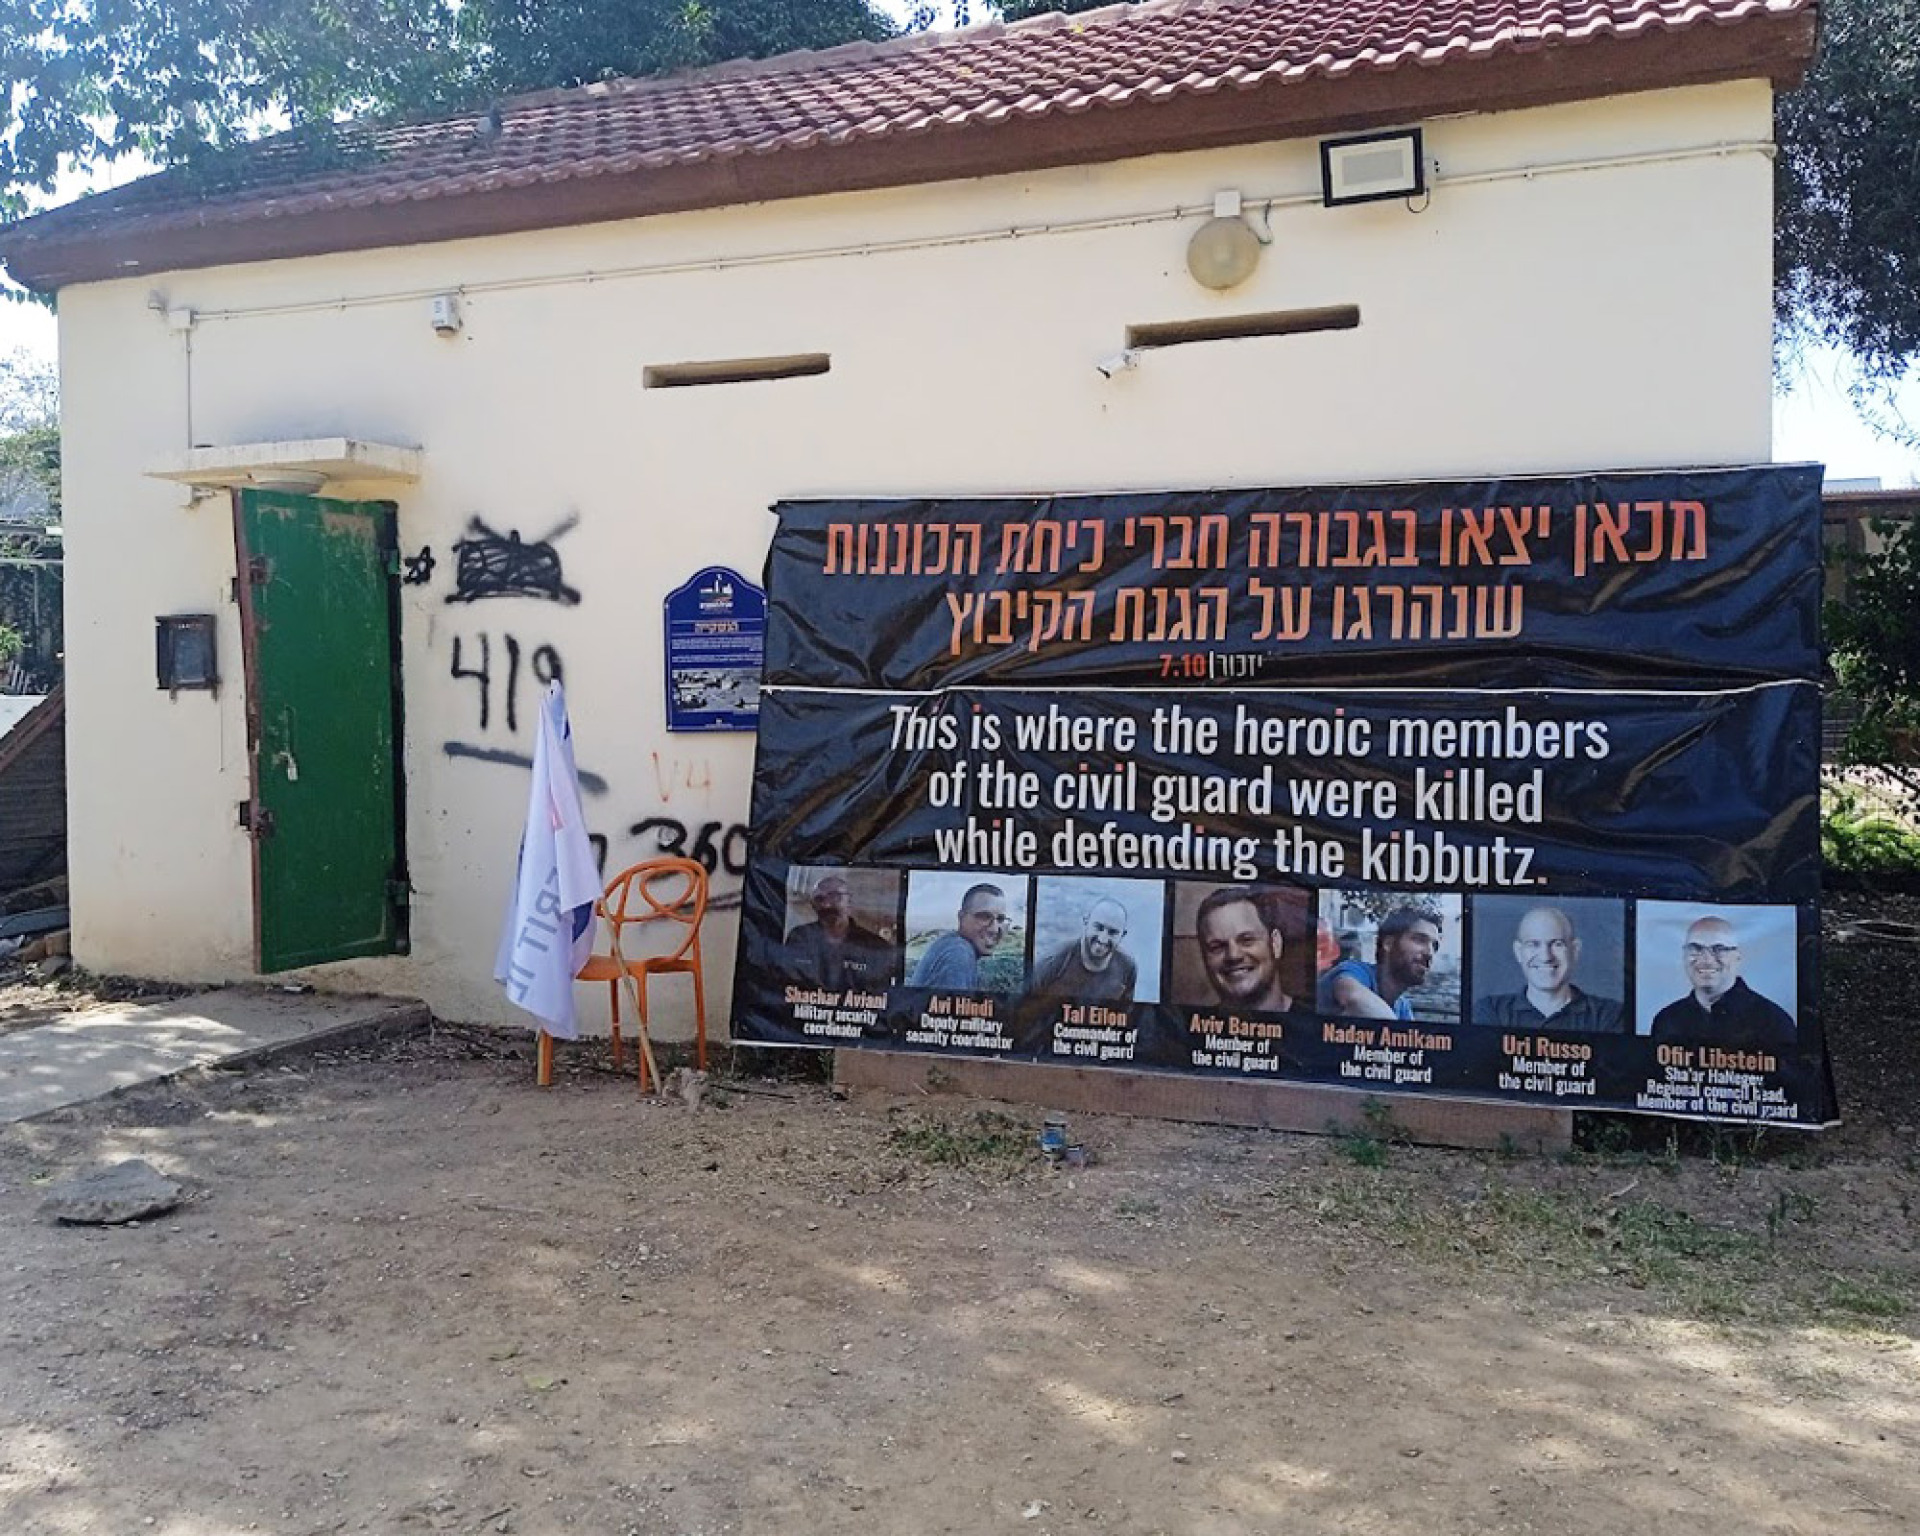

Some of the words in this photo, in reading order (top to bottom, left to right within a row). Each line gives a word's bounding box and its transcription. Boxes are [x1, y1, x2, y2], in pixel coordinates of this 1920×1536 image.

[996, 519, 1105, 574] כיתת
[1124, 513, 1230, 570] חברי
[1248, 510, 1420, 568] בגבורה
[1439, 505, 1552, 566] יצאו
[1573, 500, 1709, 577] מכאן
[823, 523, 982, 576] הכוננות
[1109, 586, 1229, 642] הגנת
[1249, 577, 1312, 641] על
[1332, 584, 1524, 641] שנהרגו
[946, 589, 1096, 656] הקיבוץ
[889, 703, 959, 751] This
[970, 703, 1002, 751] is
[1015, 704, 1136, 752] where
[1151, 704, 1219, 755] the
[1234, 704, 1372, 757] heroic
[1387, 706, 1610, 760] members
[928, 760, 968, 807] of
[977, 760, 1040, 809] the
[1054, 761, 1136, 812] civil
[1151, 765, 1272, 822] guard
[1290, 778, 1397, 821] were
[1415, 768, 1543, 823] killed
[934, 816, 1038, 868] while
[1052, 818, 1261, 881] defending
[1273, 826, 1345, 879] the
[1362, 828, 1548, 886] kibbutz.
[785, 985, 839, 1008] Shachar
[843, 988, 888, 1010] Aviani
[928, 995, 951, 1015] Avi
[955, 997, 994, 1018] Hindi
[793, 1004, 834, 1023] Military
[835, 1008, 878, 1026] security
[920, 1013, 959, 1031] Deputy
[959, 1017, 1003, 1035] military
[1061, 1003, 1085, 1024] Tal
[1089, 1006, 1128, 1028] Eilon
[1189, 1013, 1223, 1035] Aviv
[1228, 1015, 1283, 1039] Baram
[803, 1022, 863, 1039] coordinator
[905, 1029, 949, 1047] security
[950, 1032, 1014, 1051] coordinator
[1053, 1022, 1121, 1043] Commander
[1125, 1028, 1139, 1044] of
[1322, 1022, 1376, 1045] Nadav
[1380, 1025, 1452, 1051] Amikam
[1053, 1040, 1072, 1055] the
[1074, 1041, 1098, 1057] civil
[1100, 1043, 1134, 1061] guard
[1205, 1034, 1254, 1053] Member
[1257, 1039, 1270, 1054] of
[1354, 1045, 1405, 1064] Member
[1409, 1049, 1424, 1065] of
[1502, 1034, 1531, 1057] Uri
[1536, 1036, 1593, 1061] Russo
[1192, 1049, 1212, 1066] the
[1215, 1051, 1240, 1068] civil
[1242, 1054, 1279, 1073] guard
[1512, 1055, 1567, 1076] Member
[1571, 1061, 1586, 1077] of
[1656, 1043, 1694, 1066] Ofir
[1699, 1046, 1777, 1073] Libstein
[1341, 1061, 1361, 1078] the
[1365, 1062, 1391, 1080] civil
[1395, 1066, 1432, 1084] guard
[1499, 1071, 1521, 1090] the
[1524, 1074, 1551, 1093] civil
[1555, 1077, 1596, 1096] guard
[1664, 1066, 1706, 1082] Sha'ar
[1647, 1078, 1700, 1098] Regional
[1704, 1083, 1750, 1101] council
[1637, 1092, 1687, 1109] Member
[1690, 1097, 1703, 1111] of
[1707, 1098, 1729, 1113] the
[1732, 1100, 1758, 1116] civil
